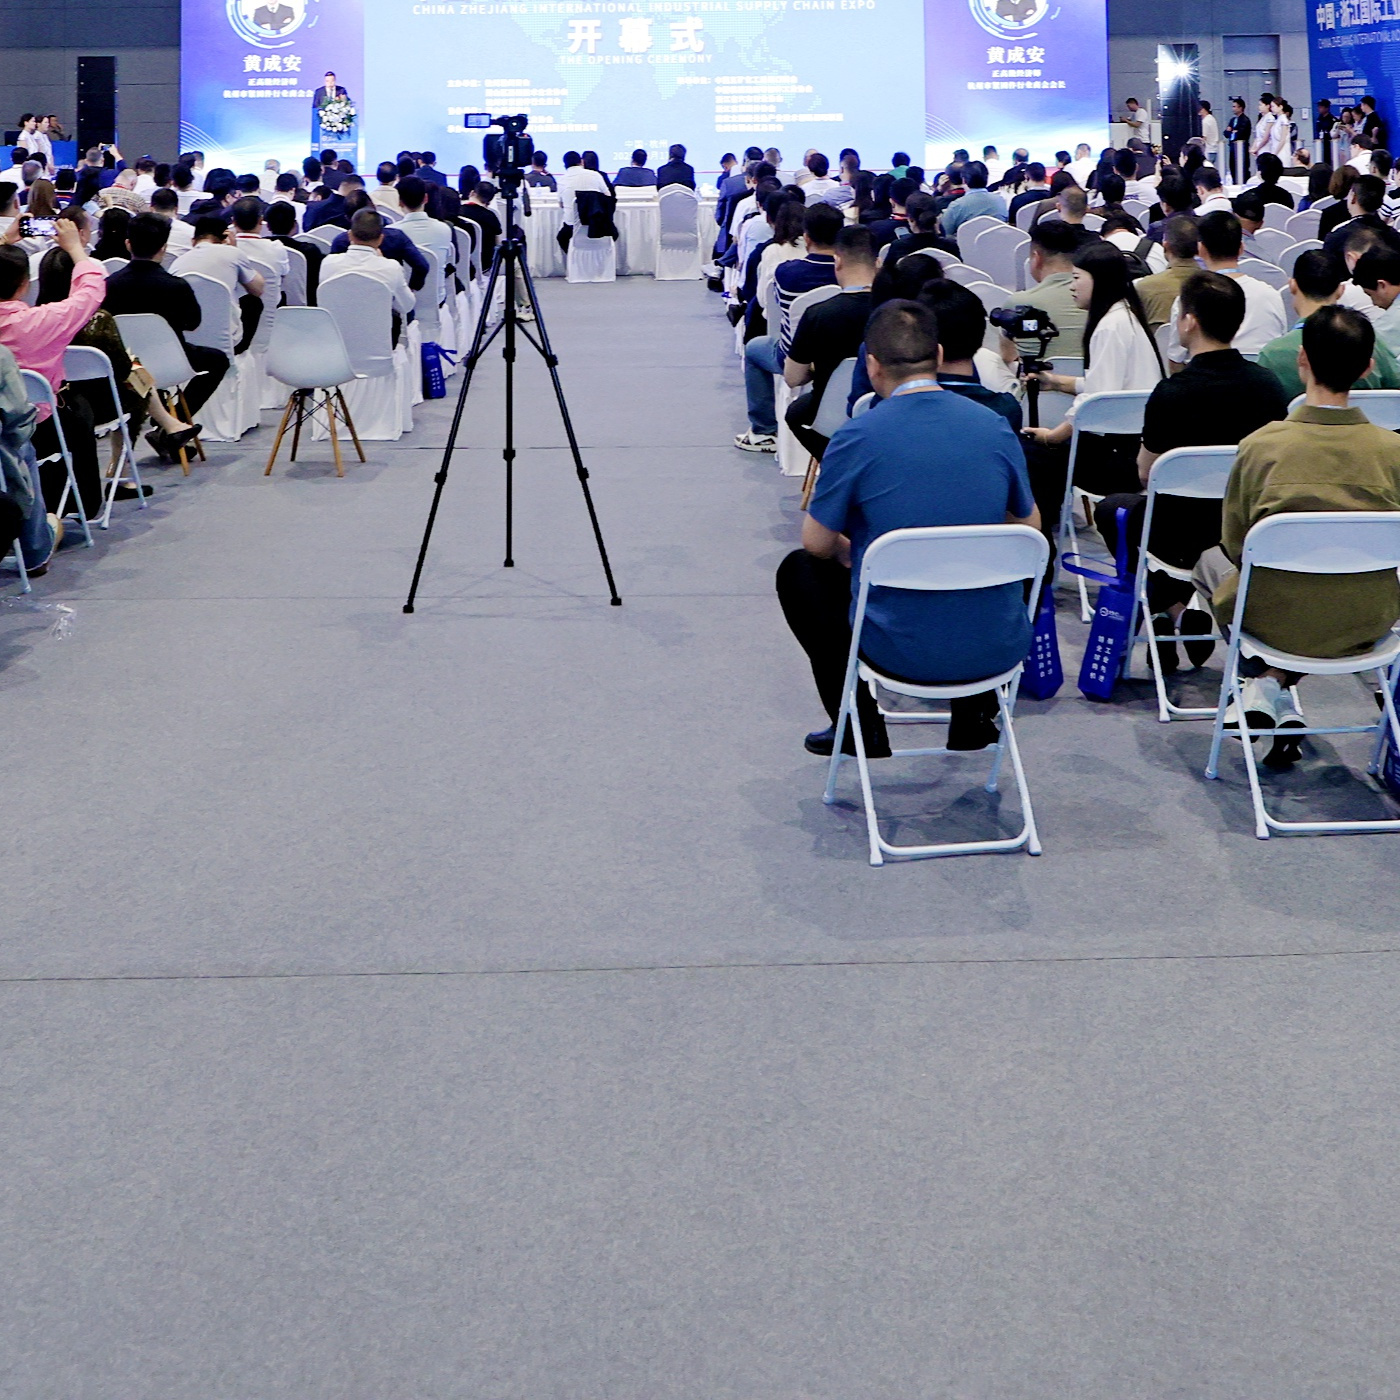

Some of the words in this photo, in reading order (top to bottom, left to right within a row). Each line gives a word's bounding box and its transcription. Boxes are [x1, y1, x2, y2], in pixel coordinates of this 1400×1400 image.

[412, 4, 455, 15] CHINA
[460, 3, 528, 15] ZHEJIANG
[533, 2, 643, 14] INTERNATIONAL
[649, 1, 731, 12] INDUSTRIAL
[736, 0, 787, 12] SUPPLY
[792, 0, 835, 11] CHAIN
[840, 0, 876, 10] EXPO
[567, 16, 705, 53] 开幕式
[243, 54, 302, 72] 黄成安
[559, 55, 582, 64] THE
[587, 54, 643, 64] OPENING
[647, 54, 713, 64] CEREMONY
[986, 46, 1045, 64] 黄成安
